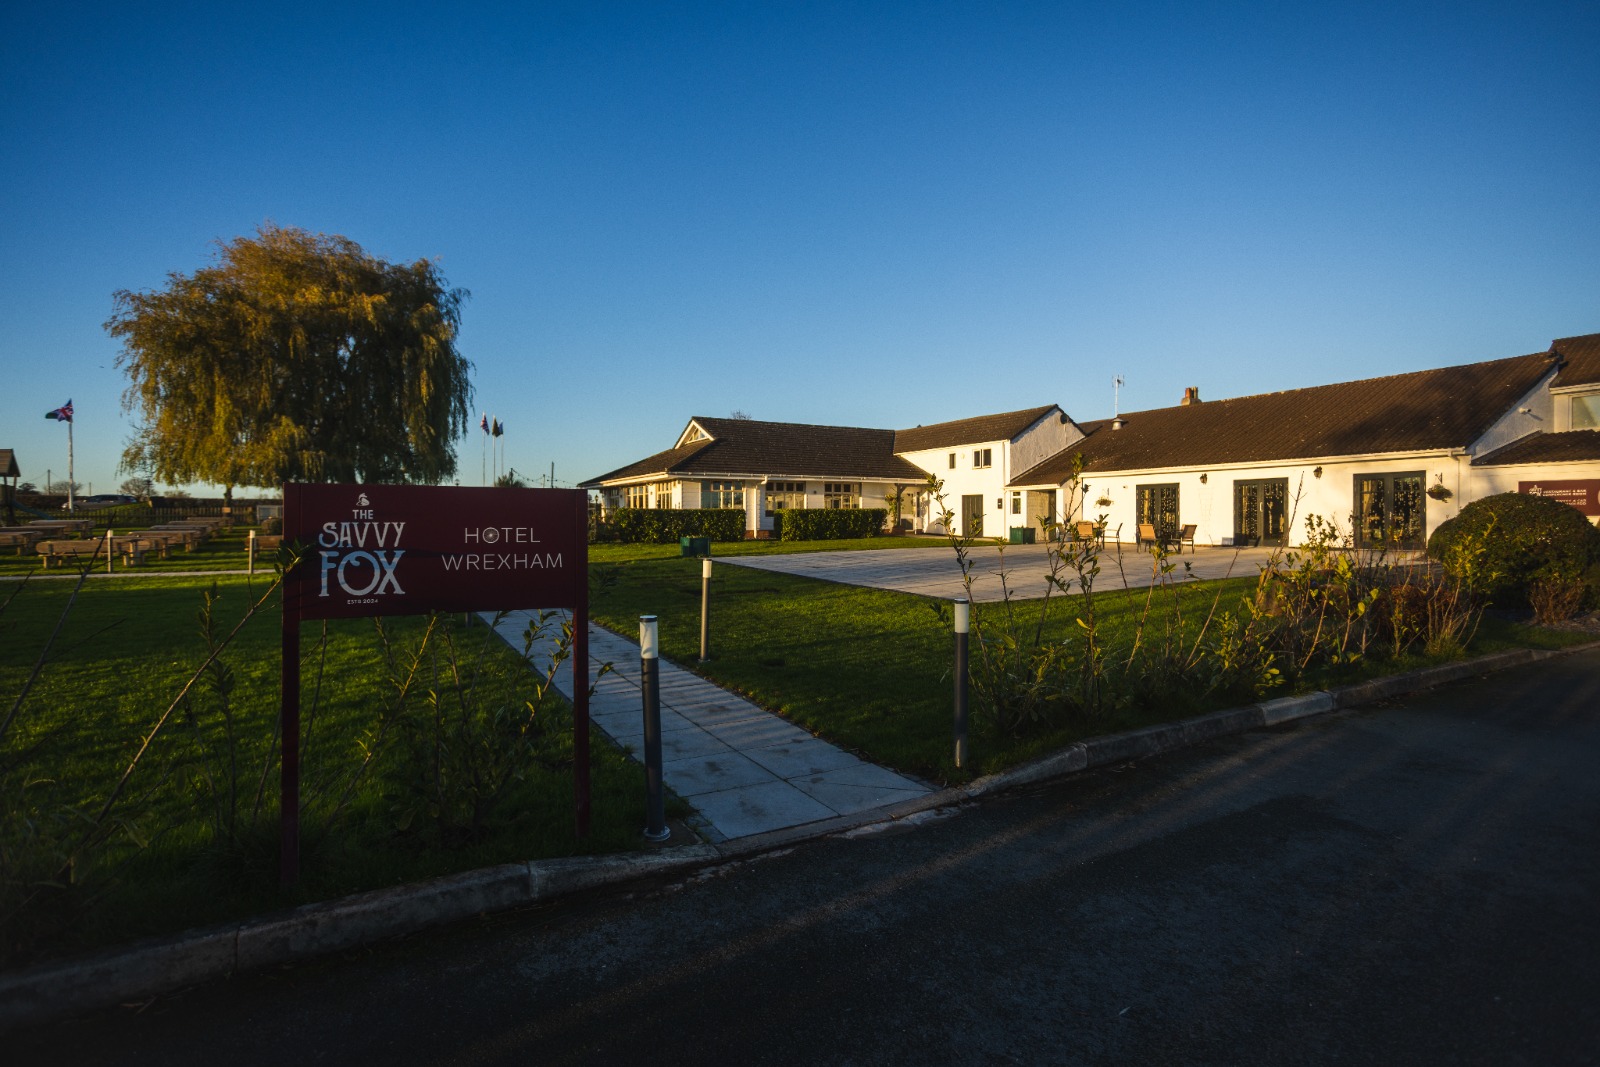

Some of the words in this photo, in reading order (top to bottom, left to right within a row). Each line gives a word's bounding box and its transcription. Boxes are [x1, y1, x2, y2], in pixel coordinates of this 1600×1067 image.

[352, 509, 374, 520] THE
[318, 521, 406, 548] SAVVY
[464, 526, 541, 544] HOTEL
[441, 552, 563, 571] WREXHAM
[318, 550, 406, 597] FOX
